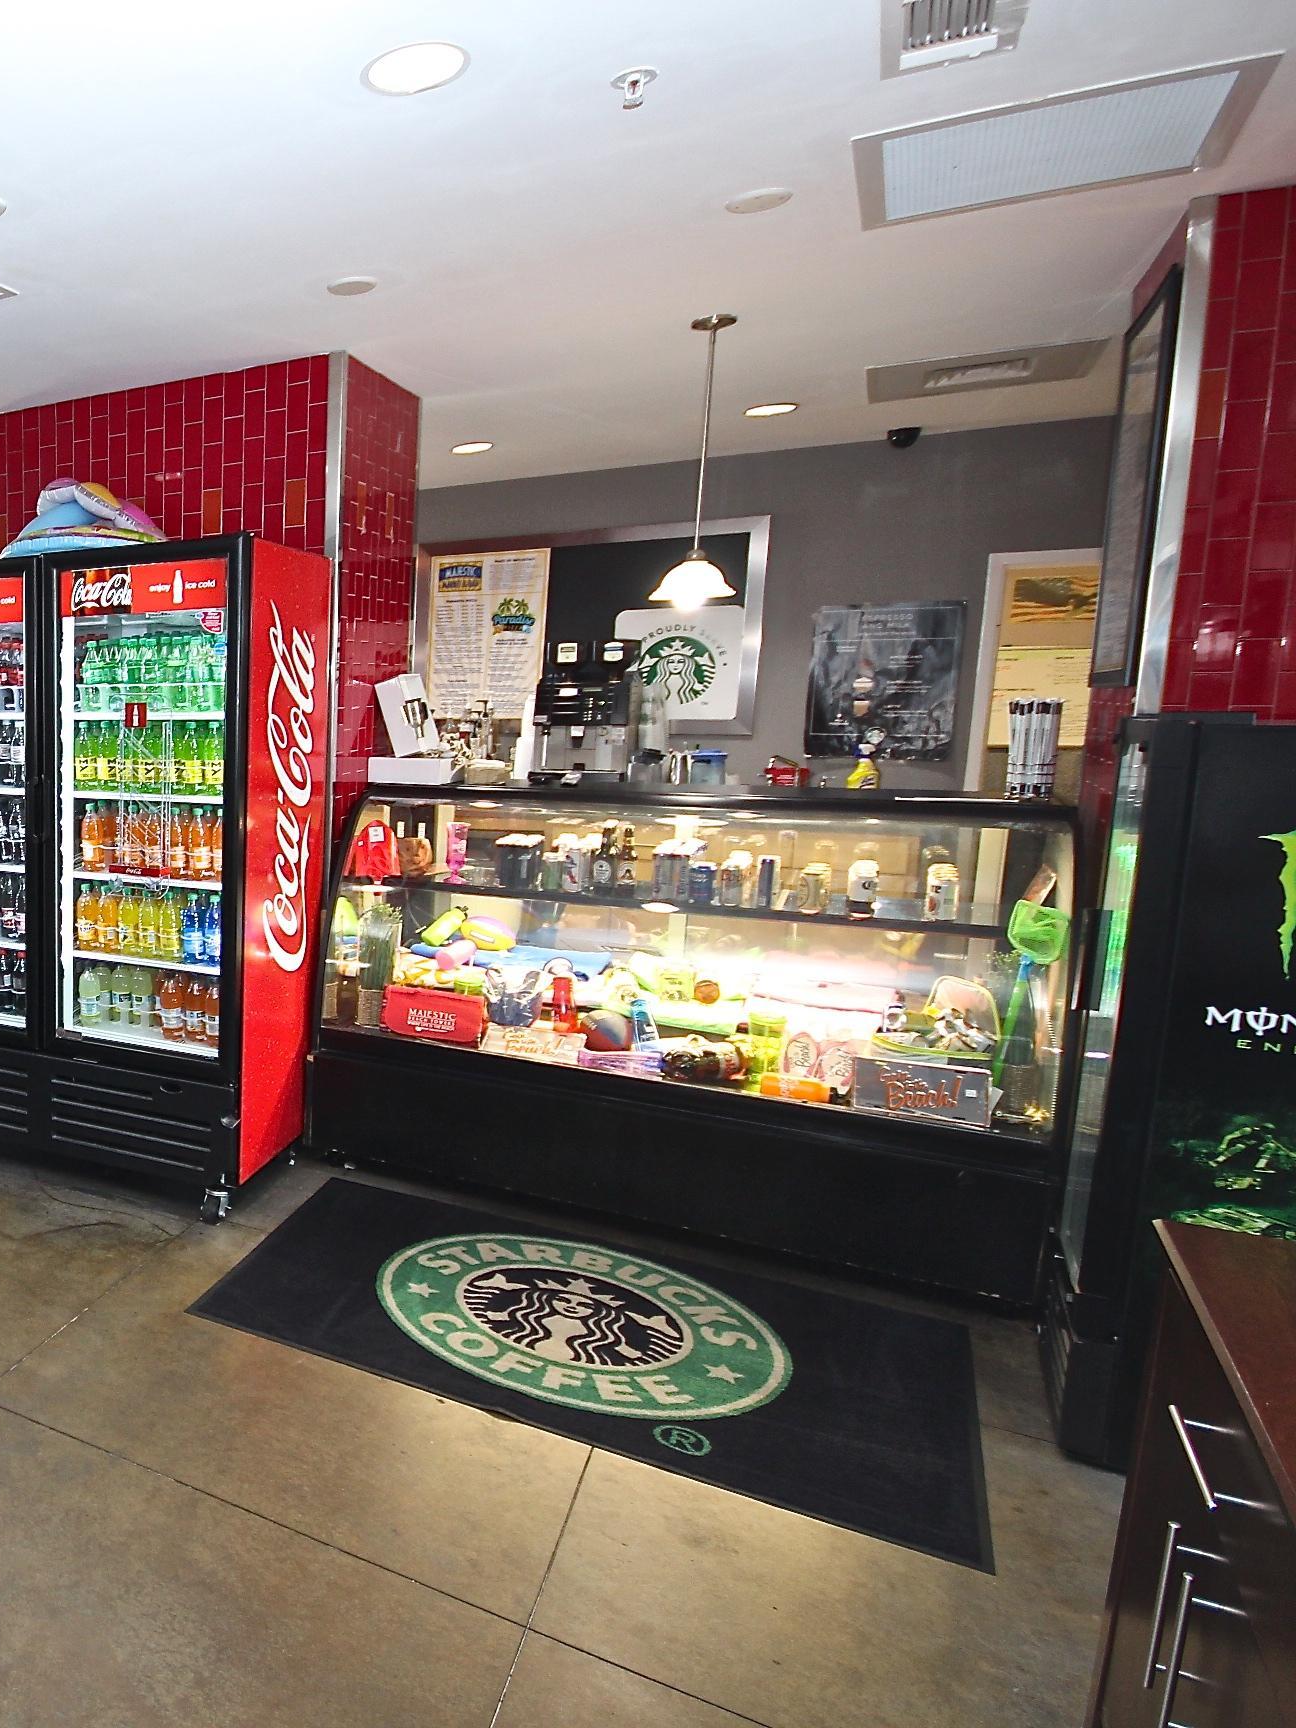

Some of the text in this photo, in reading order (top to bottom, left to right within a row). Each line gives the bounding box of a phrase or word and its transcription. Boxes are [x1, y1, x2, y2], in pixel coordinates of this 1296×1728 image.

[148, 578, 216, 593] enjoy ice cold
[0, 596, 15, 605] cold
[641, 623, 697, 643] PROUDLY
[262, 599, 316, 972] Coca-Cola
[408, 1008, 457, 1021] MAJESTIC
[886, 1075, 963, 1110] Beach!
[417, 1240, 759, 1353] STARBUCKS
[418, 1311, 696, 1406] COFFEE
